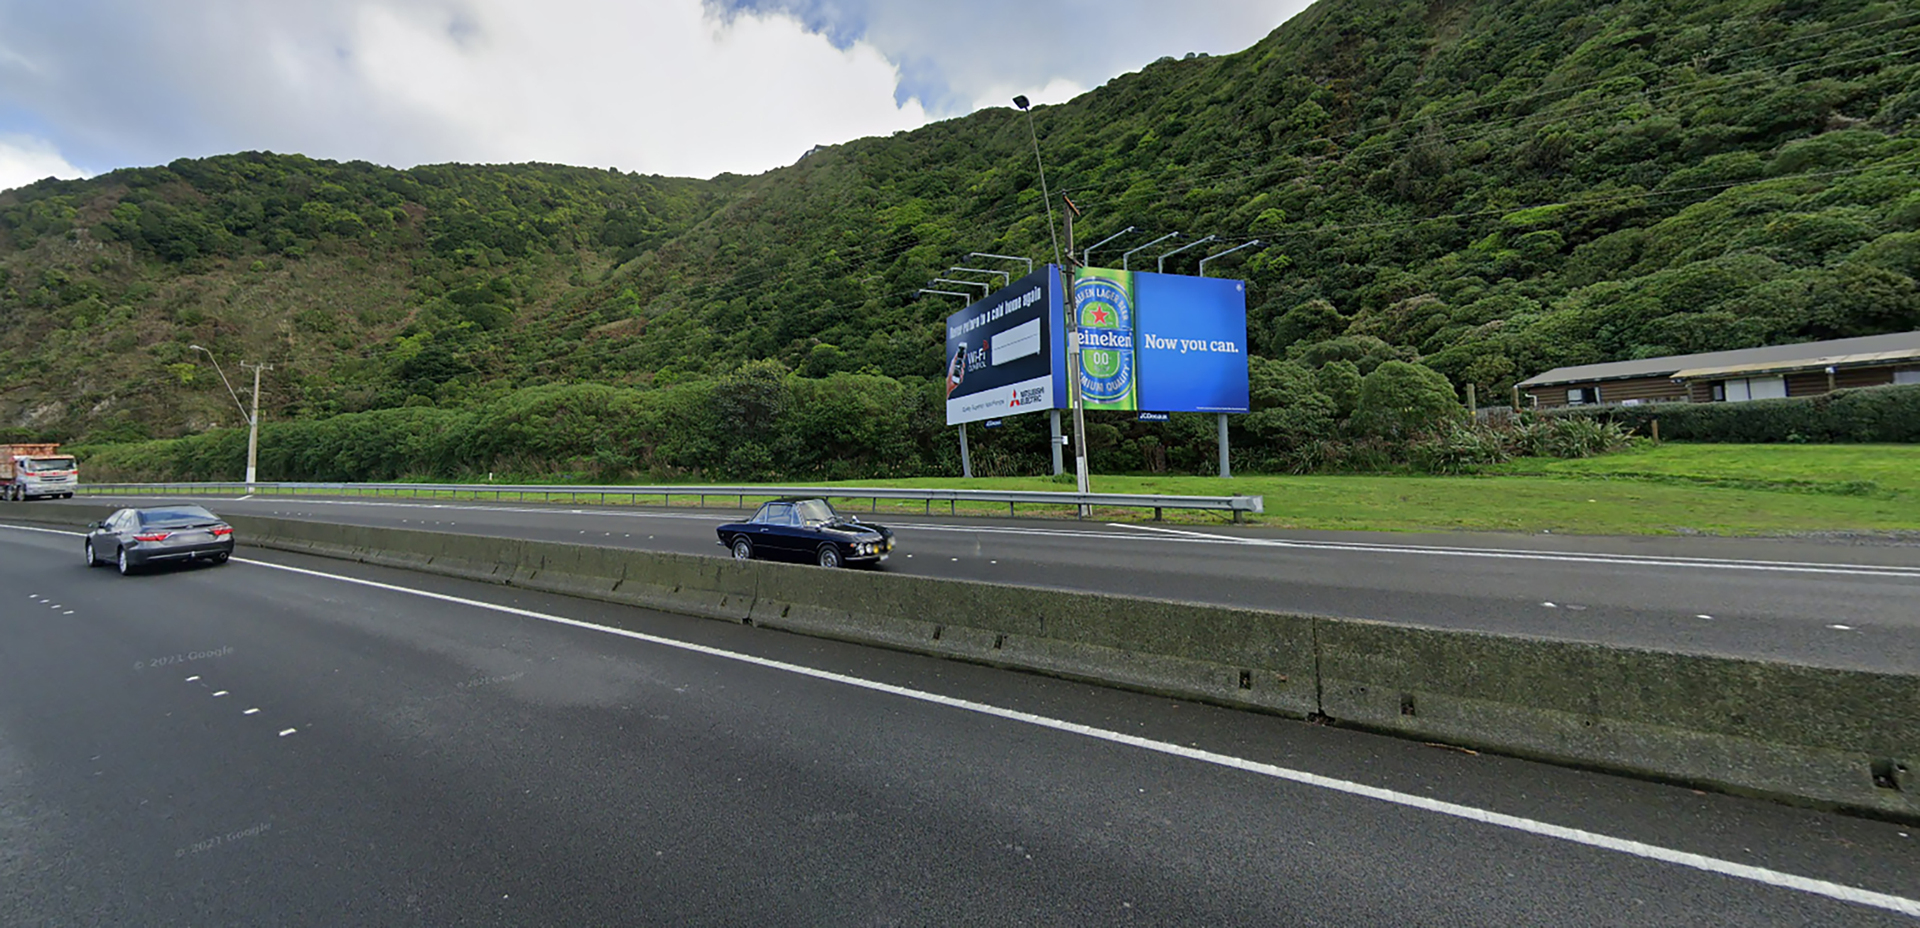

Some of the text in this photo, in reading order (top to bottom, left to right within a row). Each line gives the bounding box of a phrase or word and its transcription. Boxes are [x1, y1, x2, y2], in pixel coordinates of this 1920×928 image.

[991, 302, 1004, 321] cold
[1004, 296, 1021, 315] home
[1022, 286, 1041, 308] again
[1096, 288, 1120, 304] LAGER
[1117, 300, 1130, 321] BEER
[1078, 330, 1132, 348] eineken
[1144, 333, 1239, 354] Now you can.
[1105, 364, 1131, 391] QUALITY
